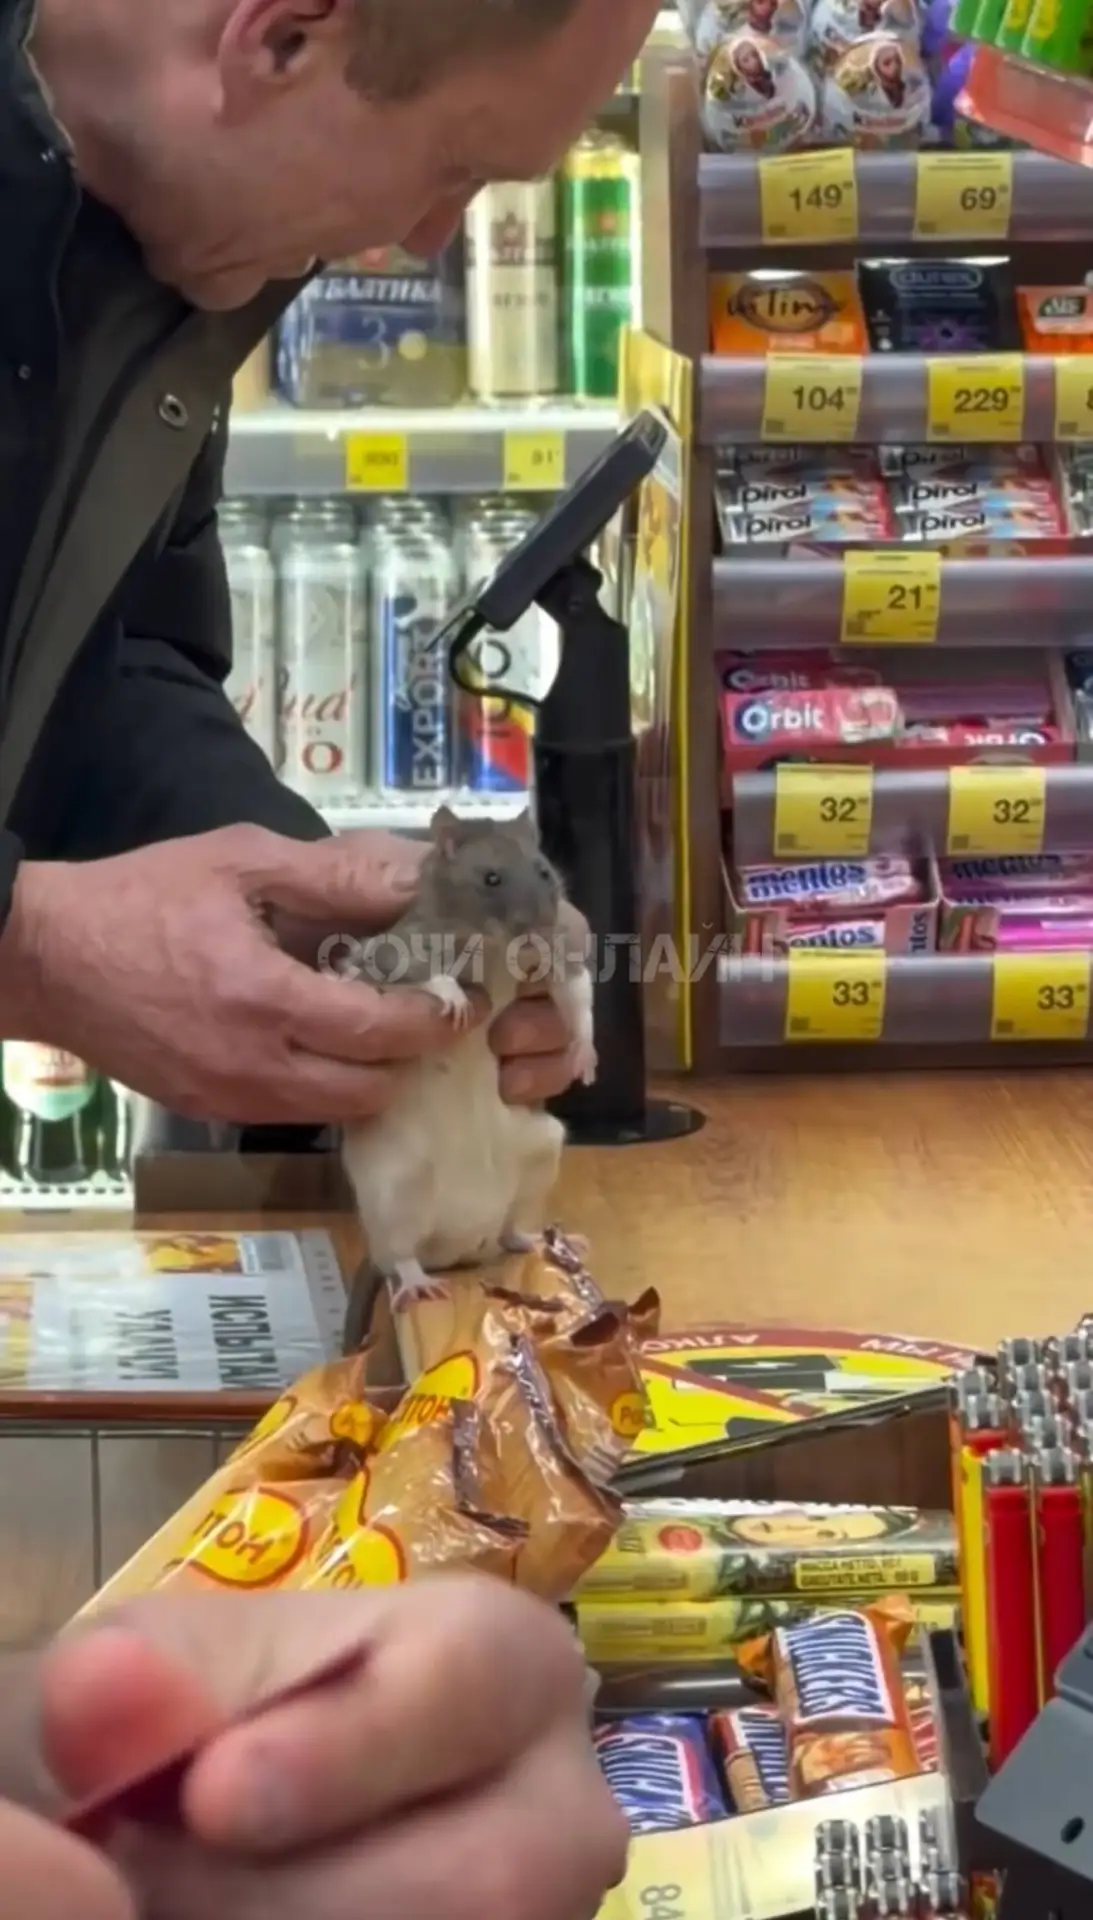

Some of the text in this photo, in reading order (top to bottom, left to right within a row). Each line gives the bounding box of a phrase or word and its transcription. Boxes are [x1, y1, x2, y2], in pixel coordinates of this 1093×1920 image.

[789, 182, 842, 213] 149
[960, 186, 997, 211] 69
[793, 386, 846, 411] 104
[954, 388, 1009, 413] 229
[888, 585, 923, 610] 21
[741, 701, 825, 731] Orbit
[820, 797, 857, 822] 32
[993, 799, 1030, 824] 32
[747, 859, 867, 897] mentos
[833, 980, 870, 1006] 33
[1037, 985, 1074, 1010] 33
[786, 1612, 886, 1717] SNICKERS
